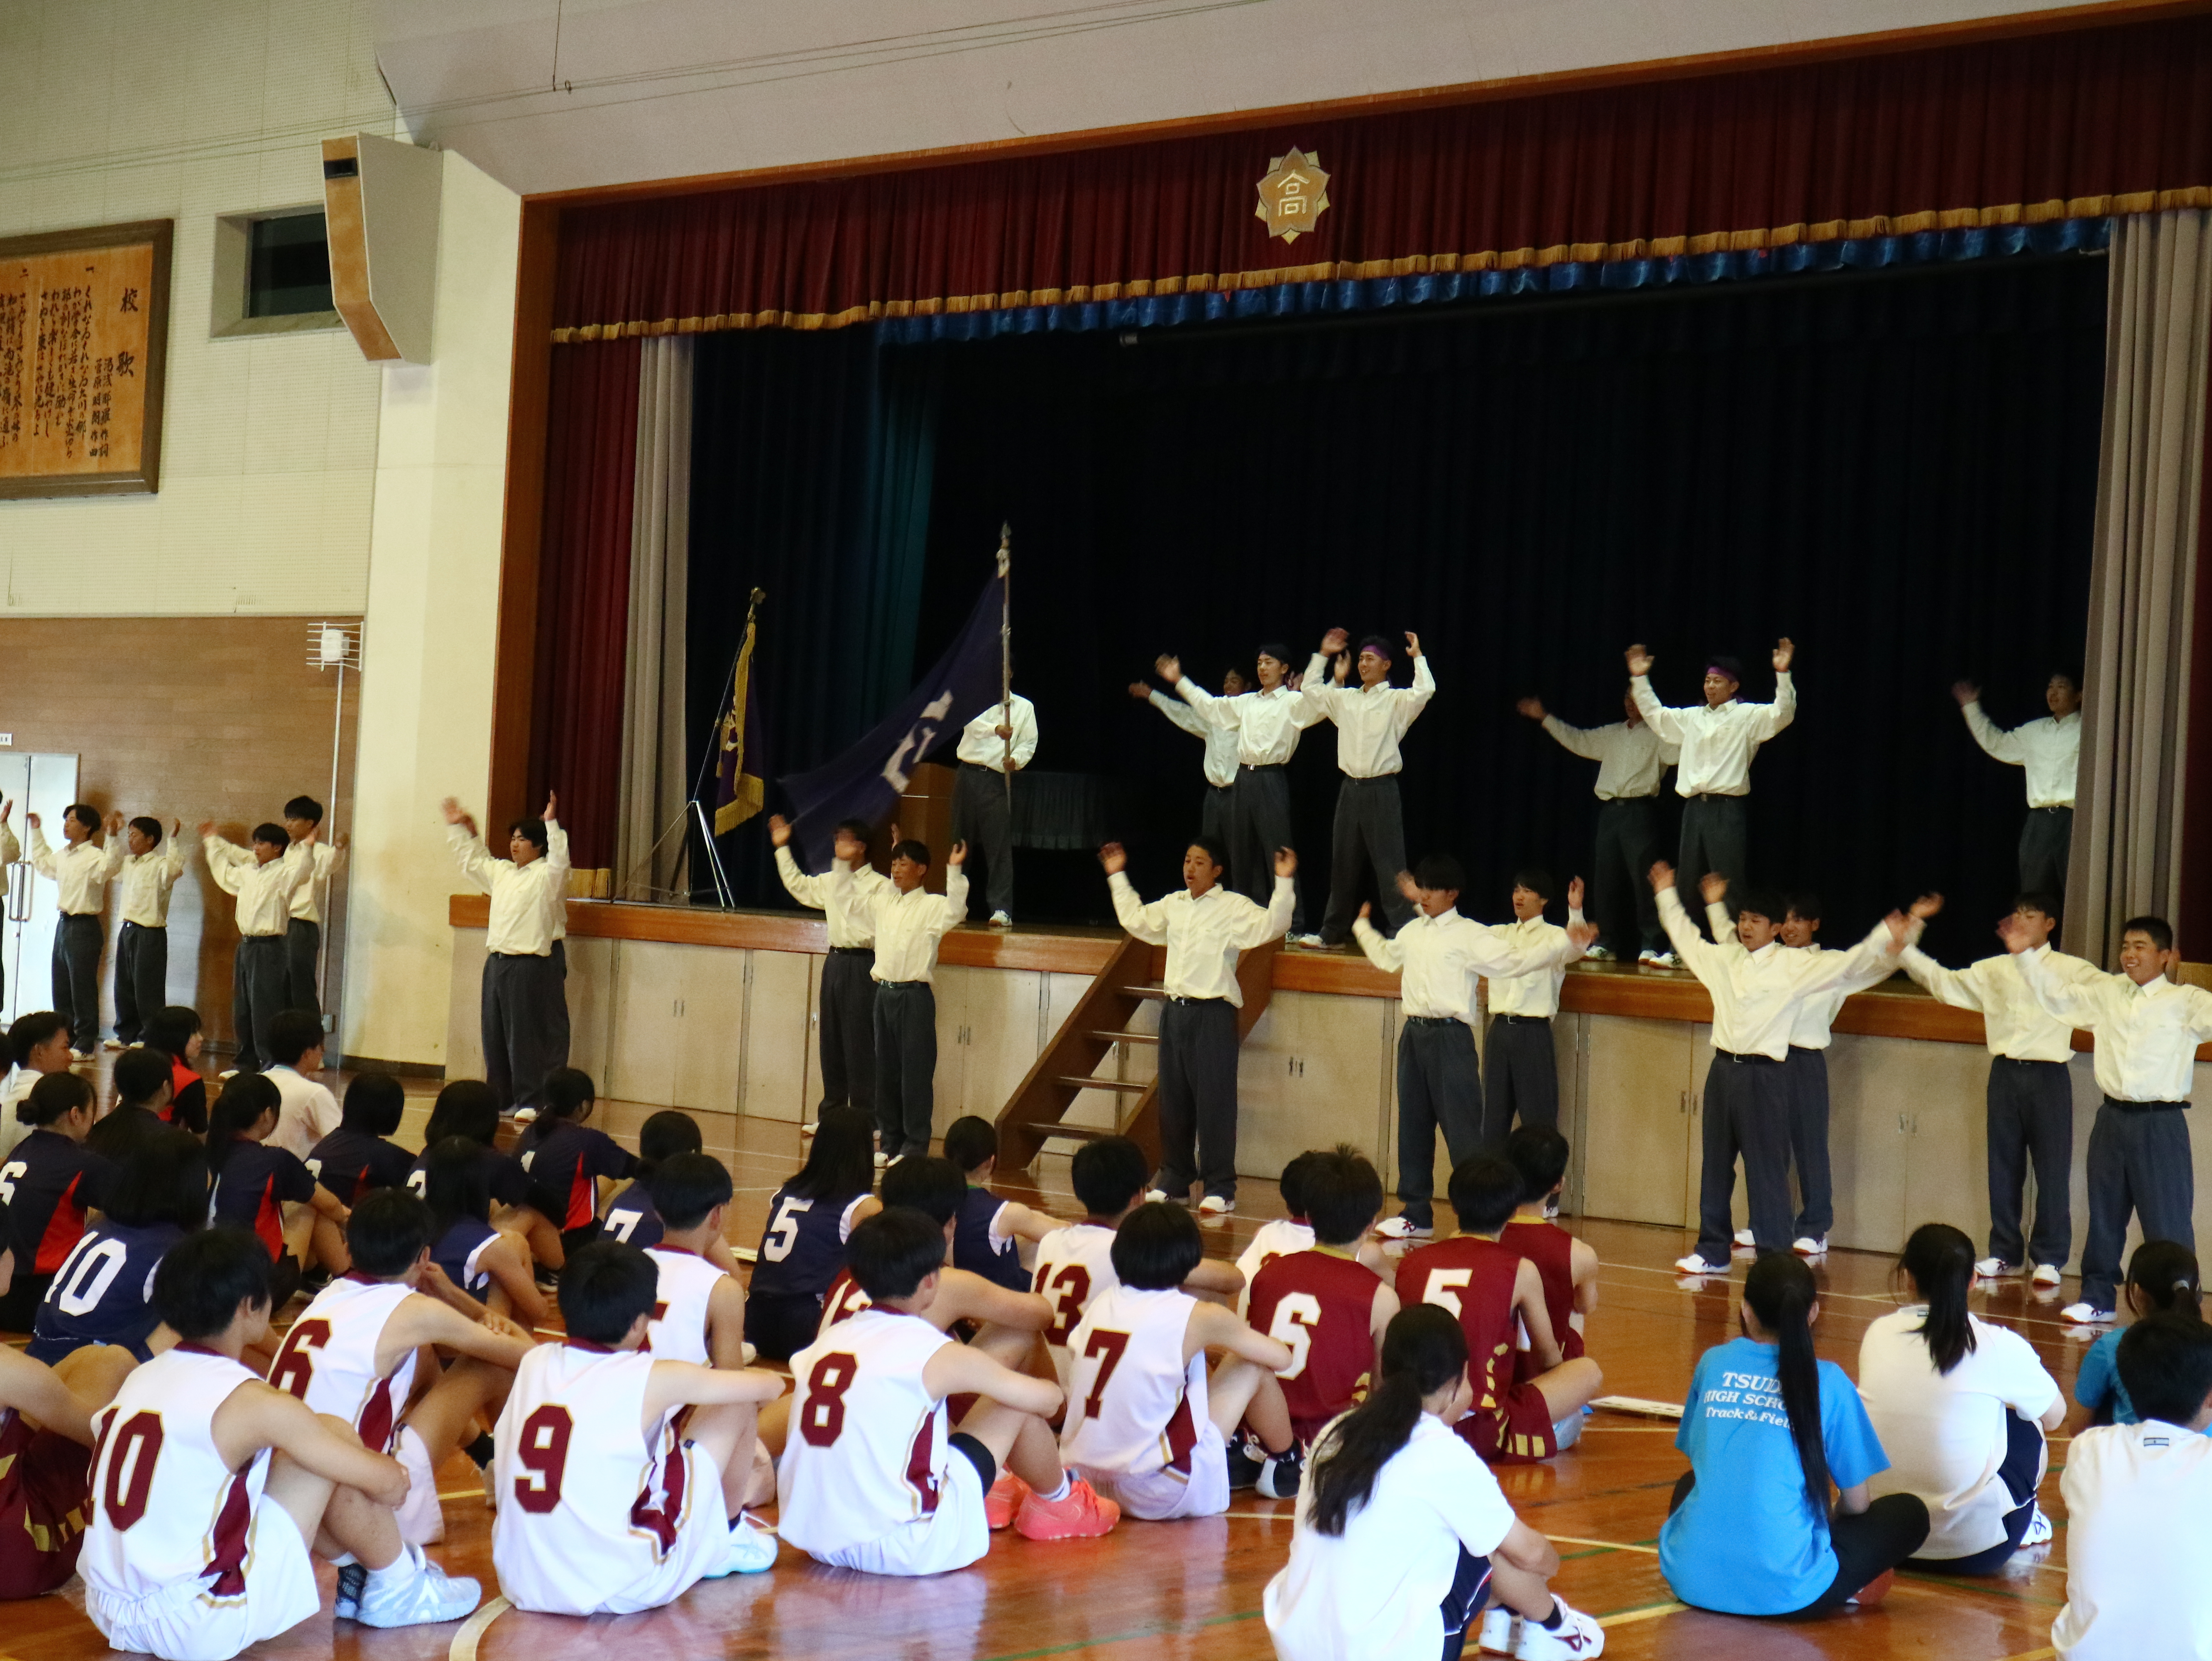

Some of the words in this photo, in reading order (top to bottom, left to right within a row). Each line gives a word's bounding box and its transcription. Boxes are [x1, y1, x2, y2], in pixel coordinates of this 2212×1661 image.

[763, 1196, 814, 1263] 5
[44, 1231, 127, 1317] 10
[266, 1318, 333, 1400] 6
[1084, 1328, 1130, 1420] 7
[1269, 1292, 1321, 1380] 6
[800, 1351, 858, 1450] 8
[1703, 1390, 1740, 1404] HIGH
[1705, 1407, 1744, 1419] Track
[1745, 1410, 1757, 1421] &
[1759, 1412, 1790, 1428] Fiel
[1722, 1372, 1782, 1394] TSUD
[86, 1405, 165, 1534] 10
[514, 1402, 575, 1515] 9
